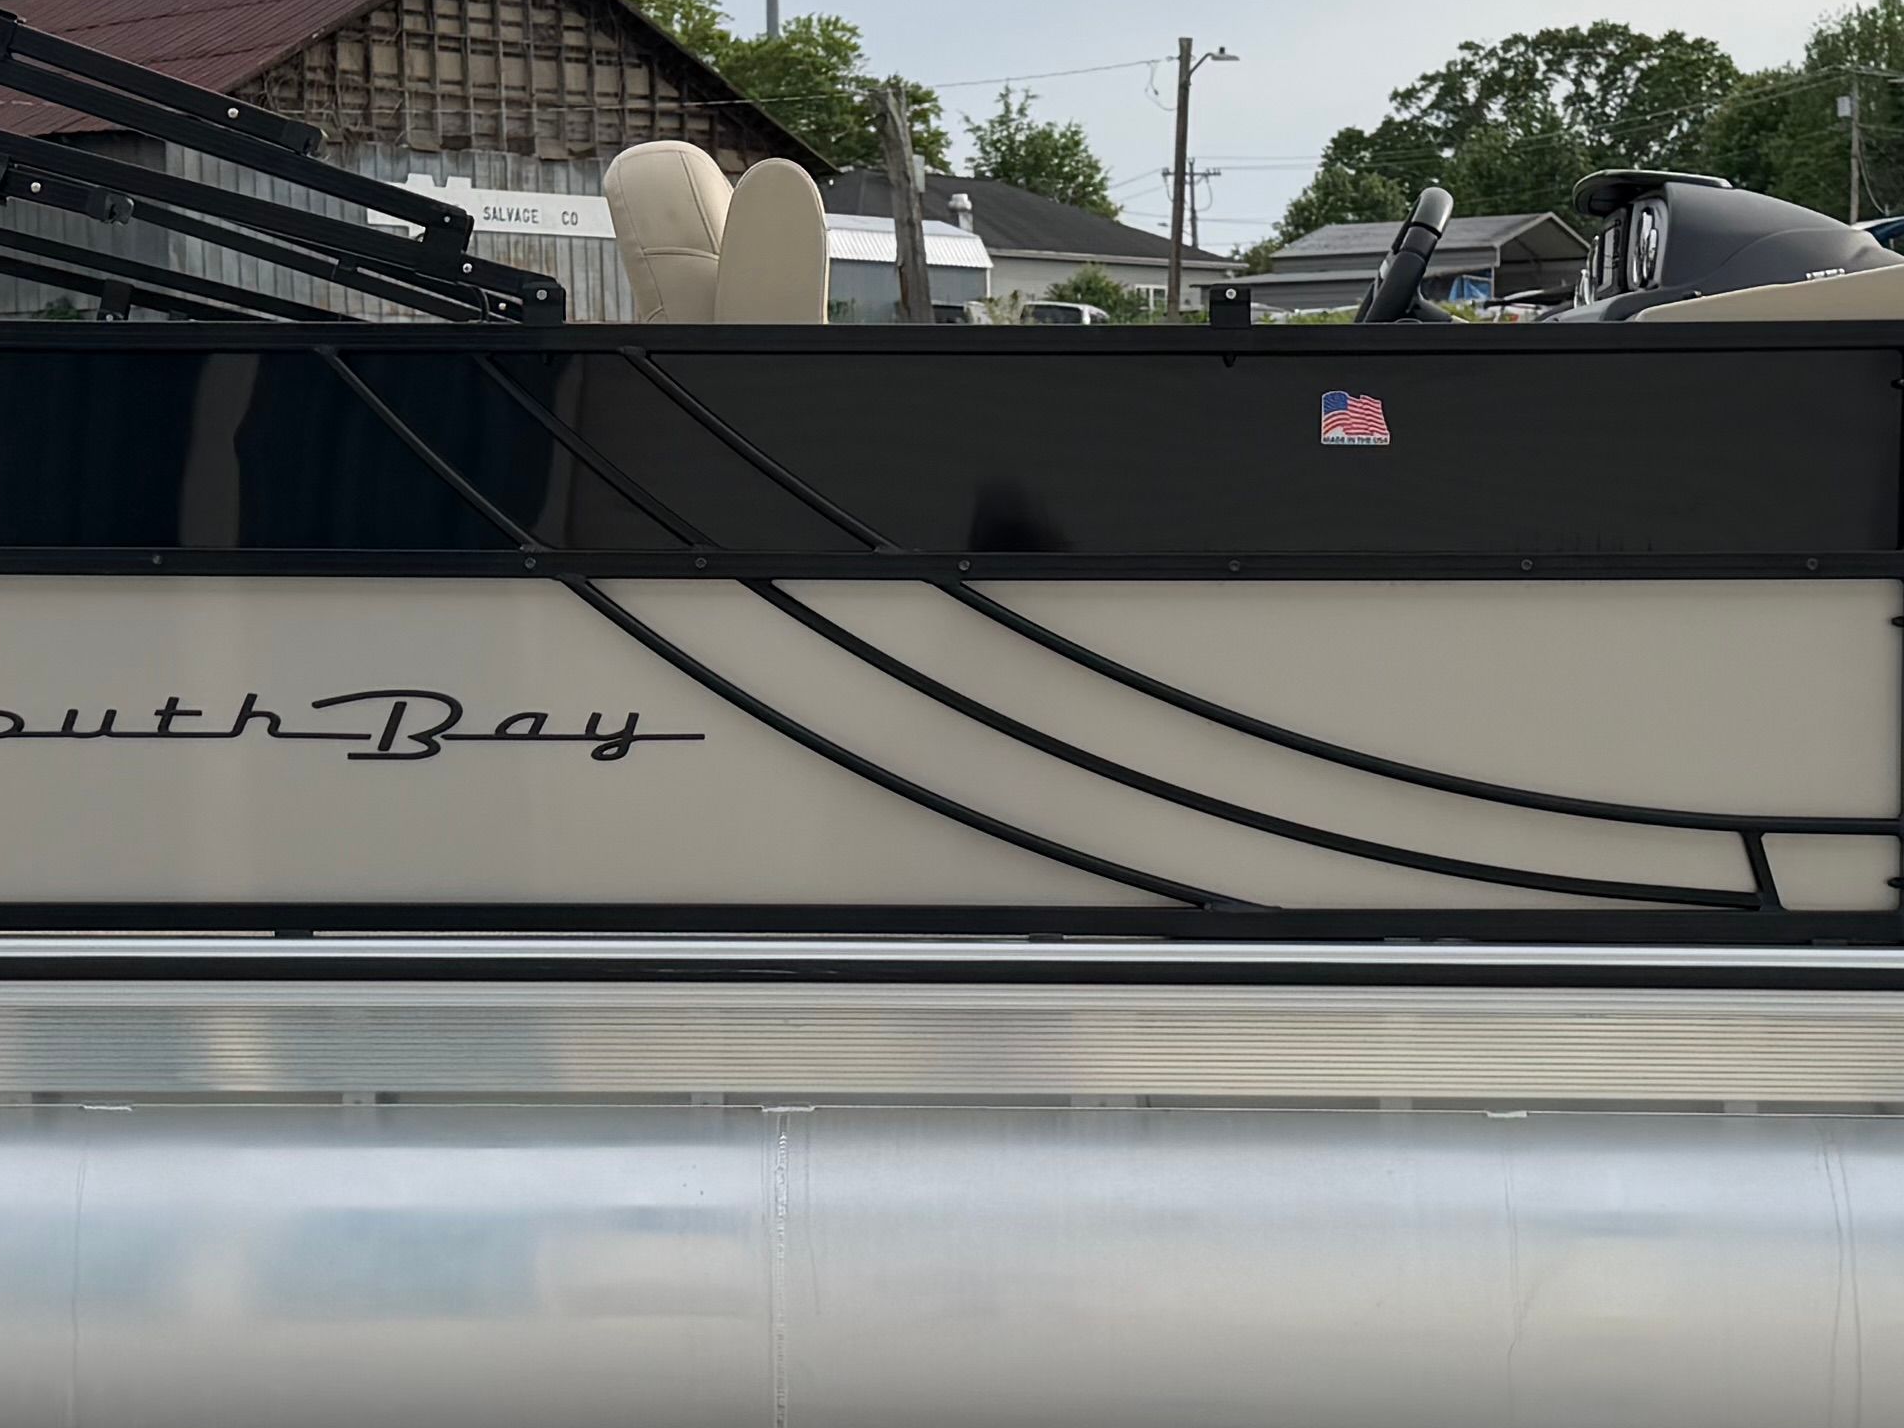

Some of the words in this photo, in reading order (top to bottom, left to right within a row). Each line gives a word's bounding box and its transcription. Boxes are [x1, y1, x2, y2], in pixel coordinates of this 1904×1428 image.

[483, 206, 539, 224] SALVAGE
[561, 210, 578, 226] CO
[311, 689, 706, 760] Bay
